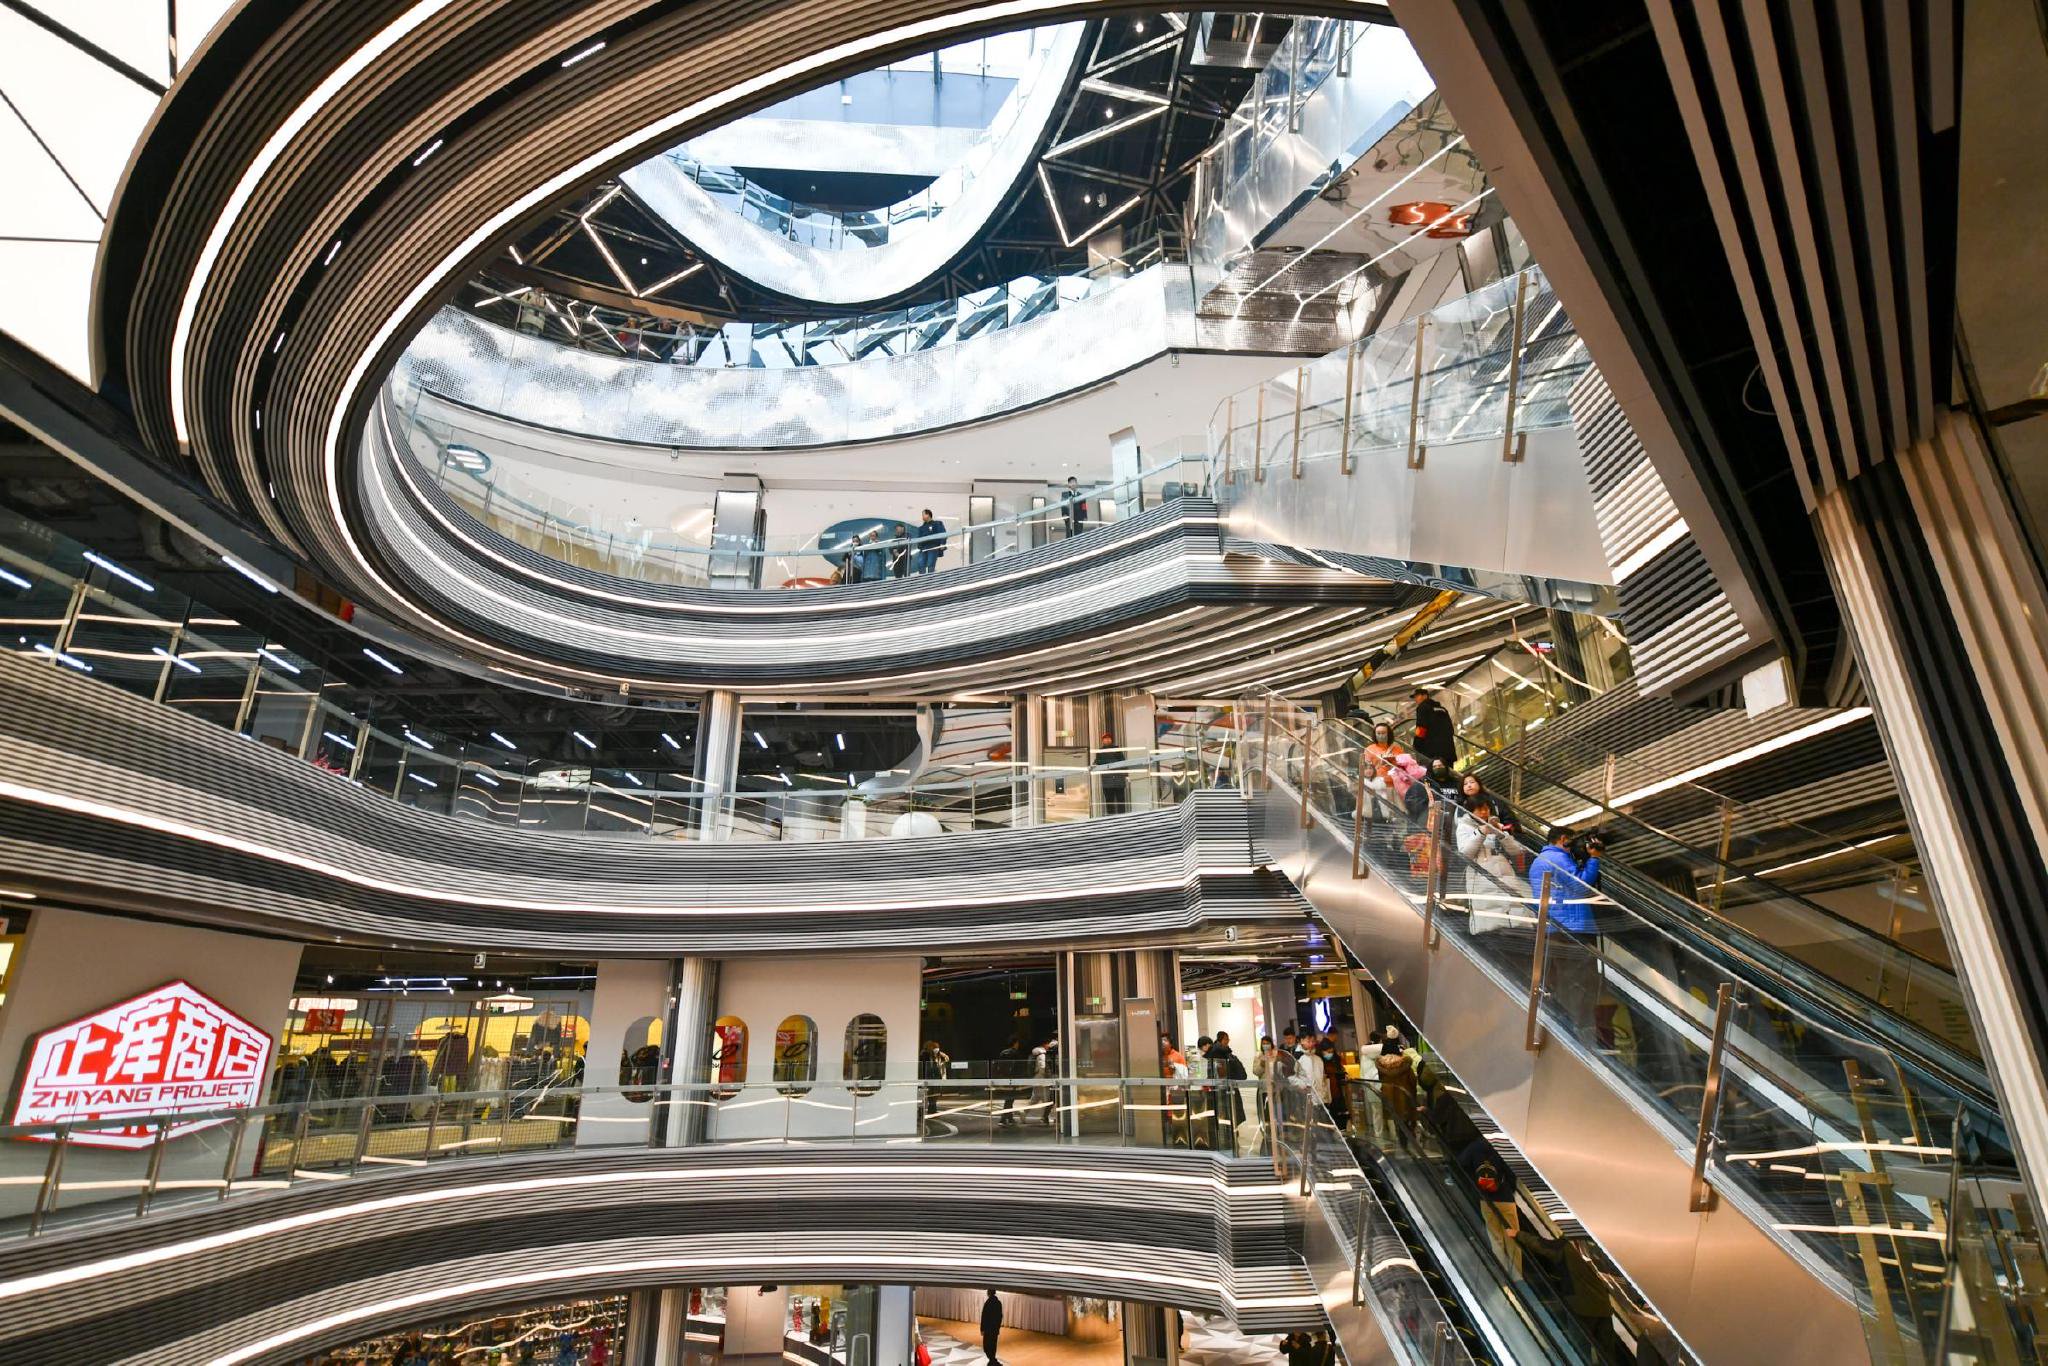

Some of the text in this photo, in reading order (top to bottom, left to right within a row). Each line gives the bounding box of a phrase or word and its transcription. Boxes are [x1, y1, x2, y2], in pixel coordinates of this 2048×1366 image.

[36, 997, 262, 1087] 止痒商店
[29, 1081, 254, 1108] ZHIYANG PROJECT
